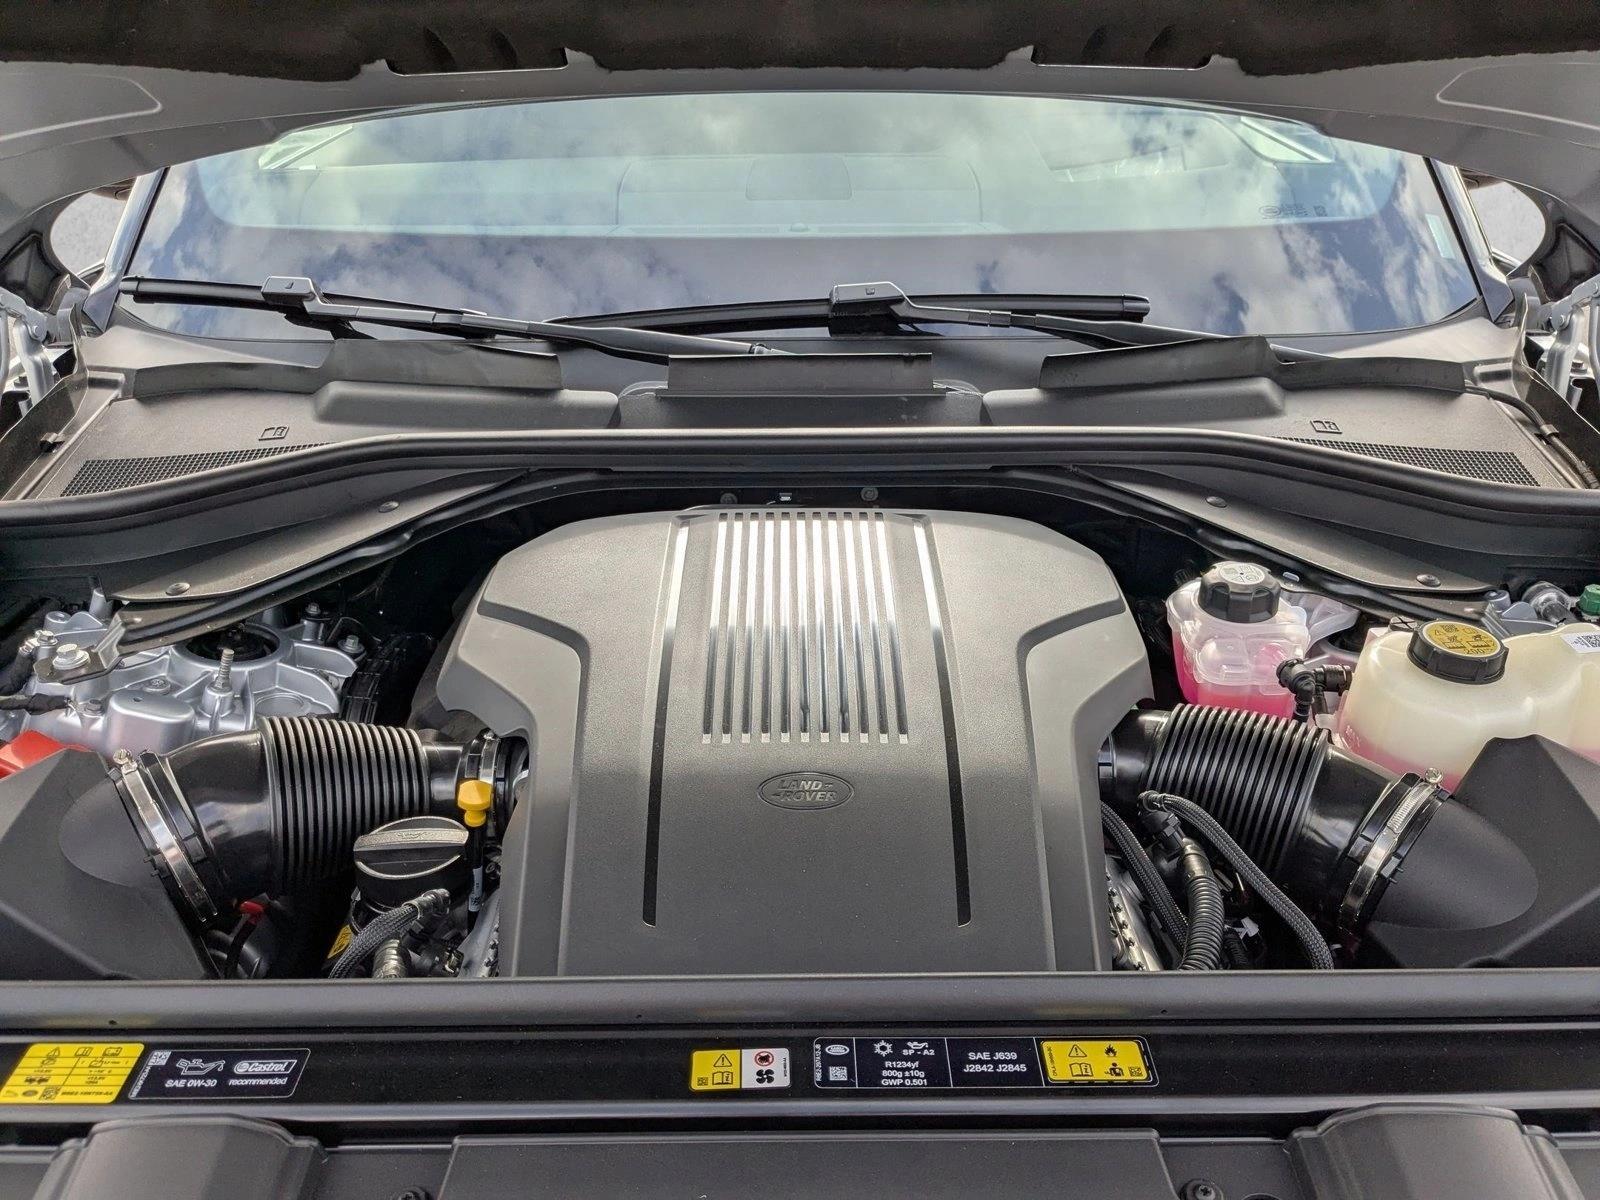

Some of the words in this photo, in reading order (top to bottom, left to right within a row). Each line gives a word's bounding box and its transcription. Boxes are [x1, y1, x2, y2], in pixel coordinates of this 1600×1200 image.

[777, 779, 823, 790] LAND
[780, 790, 838, 802] ROVER
[968, 1052, 992, 1060] SAE
[993, 1052, 1018, 1060] J639
[248, 1062, 288, 1072] Castrol
[885, 1061, 919, 1069] R1234yf
[963, 1064, 994, 1073] J2842
[996, 1064, 1027, 1072] J2845
[165, 1079, 187, 1088] SAE
[187, 1079, 218, 1087] 0W-30
[229, 1077, 288, 1086] recommended
